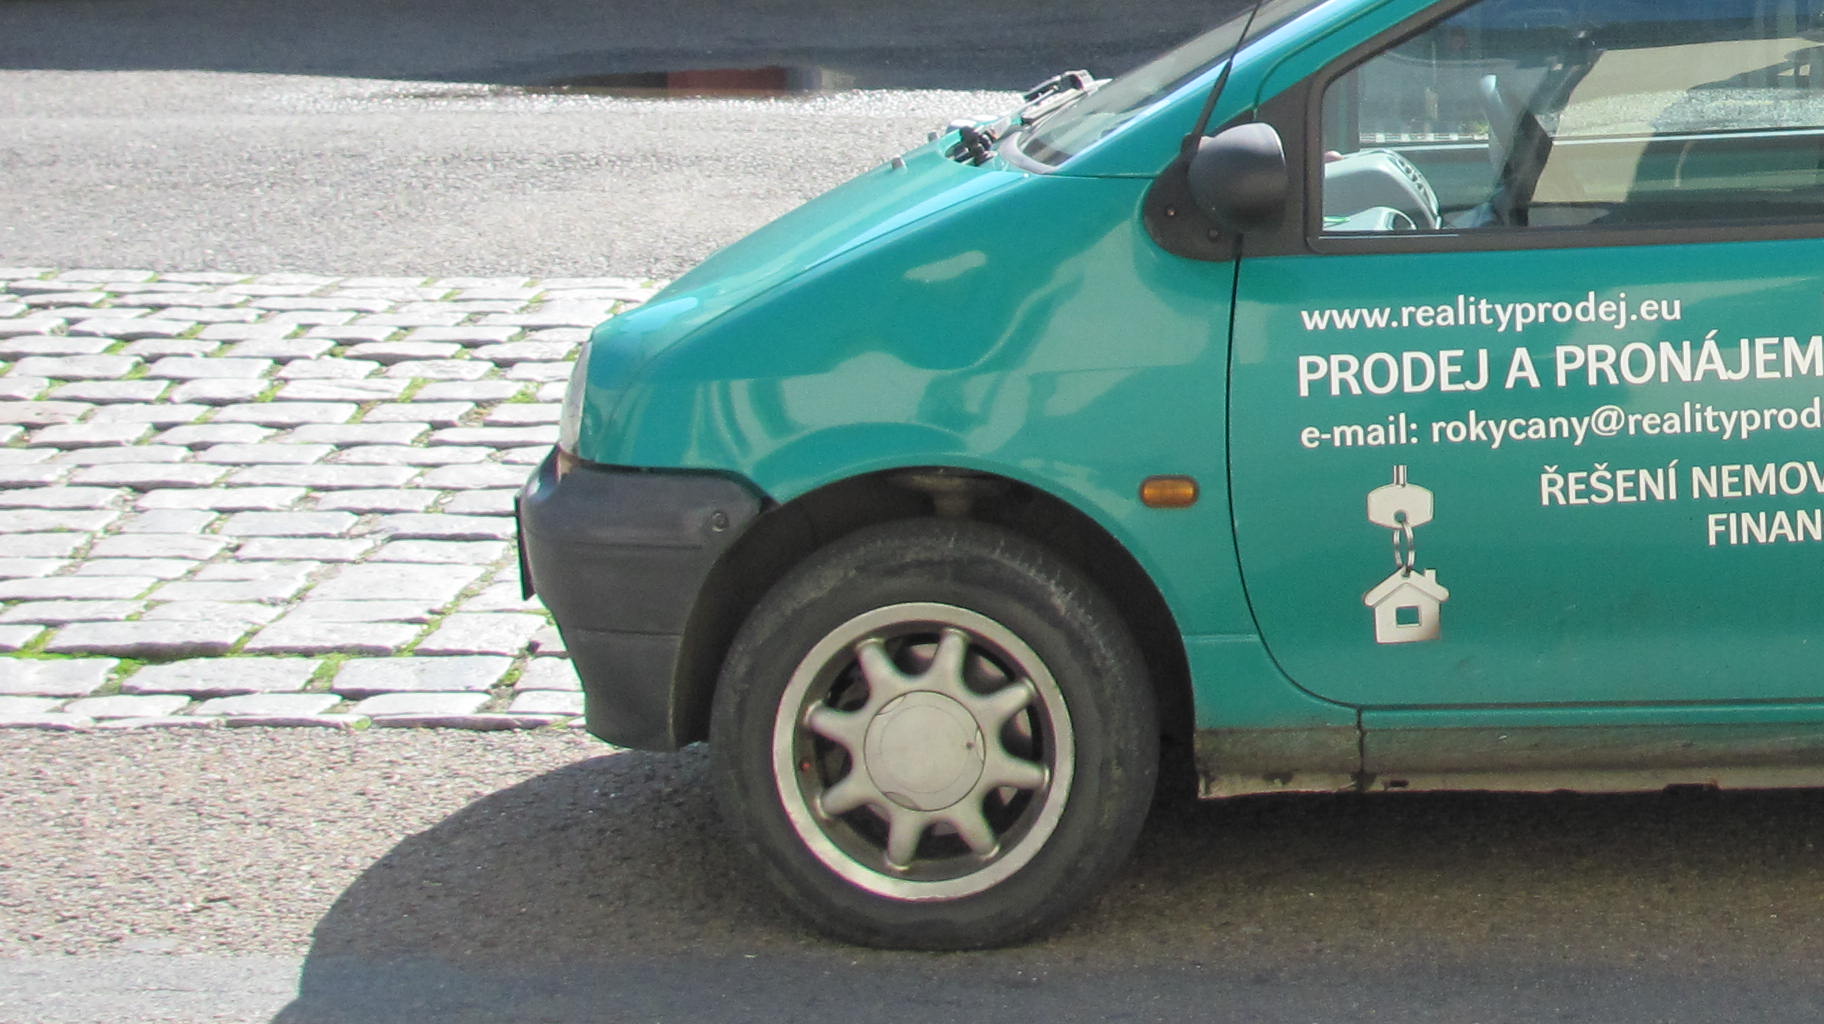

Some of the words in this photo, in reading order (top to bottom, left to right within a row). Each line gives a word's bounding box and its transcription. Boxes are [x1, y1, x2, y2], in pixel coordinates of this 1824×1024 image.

[1301, 291, 1681, 332] www.realityprodej.eu
[1298, 348, 1489, 397] PRODEJ
[1505, 346, 1540, 389] A
[1555, 330, 1824, 386] PRONÁJEM
[1300, 412, 1419, 448] e-mail:
[1540, 459, 1679, 506] ŘEŠENÍ
